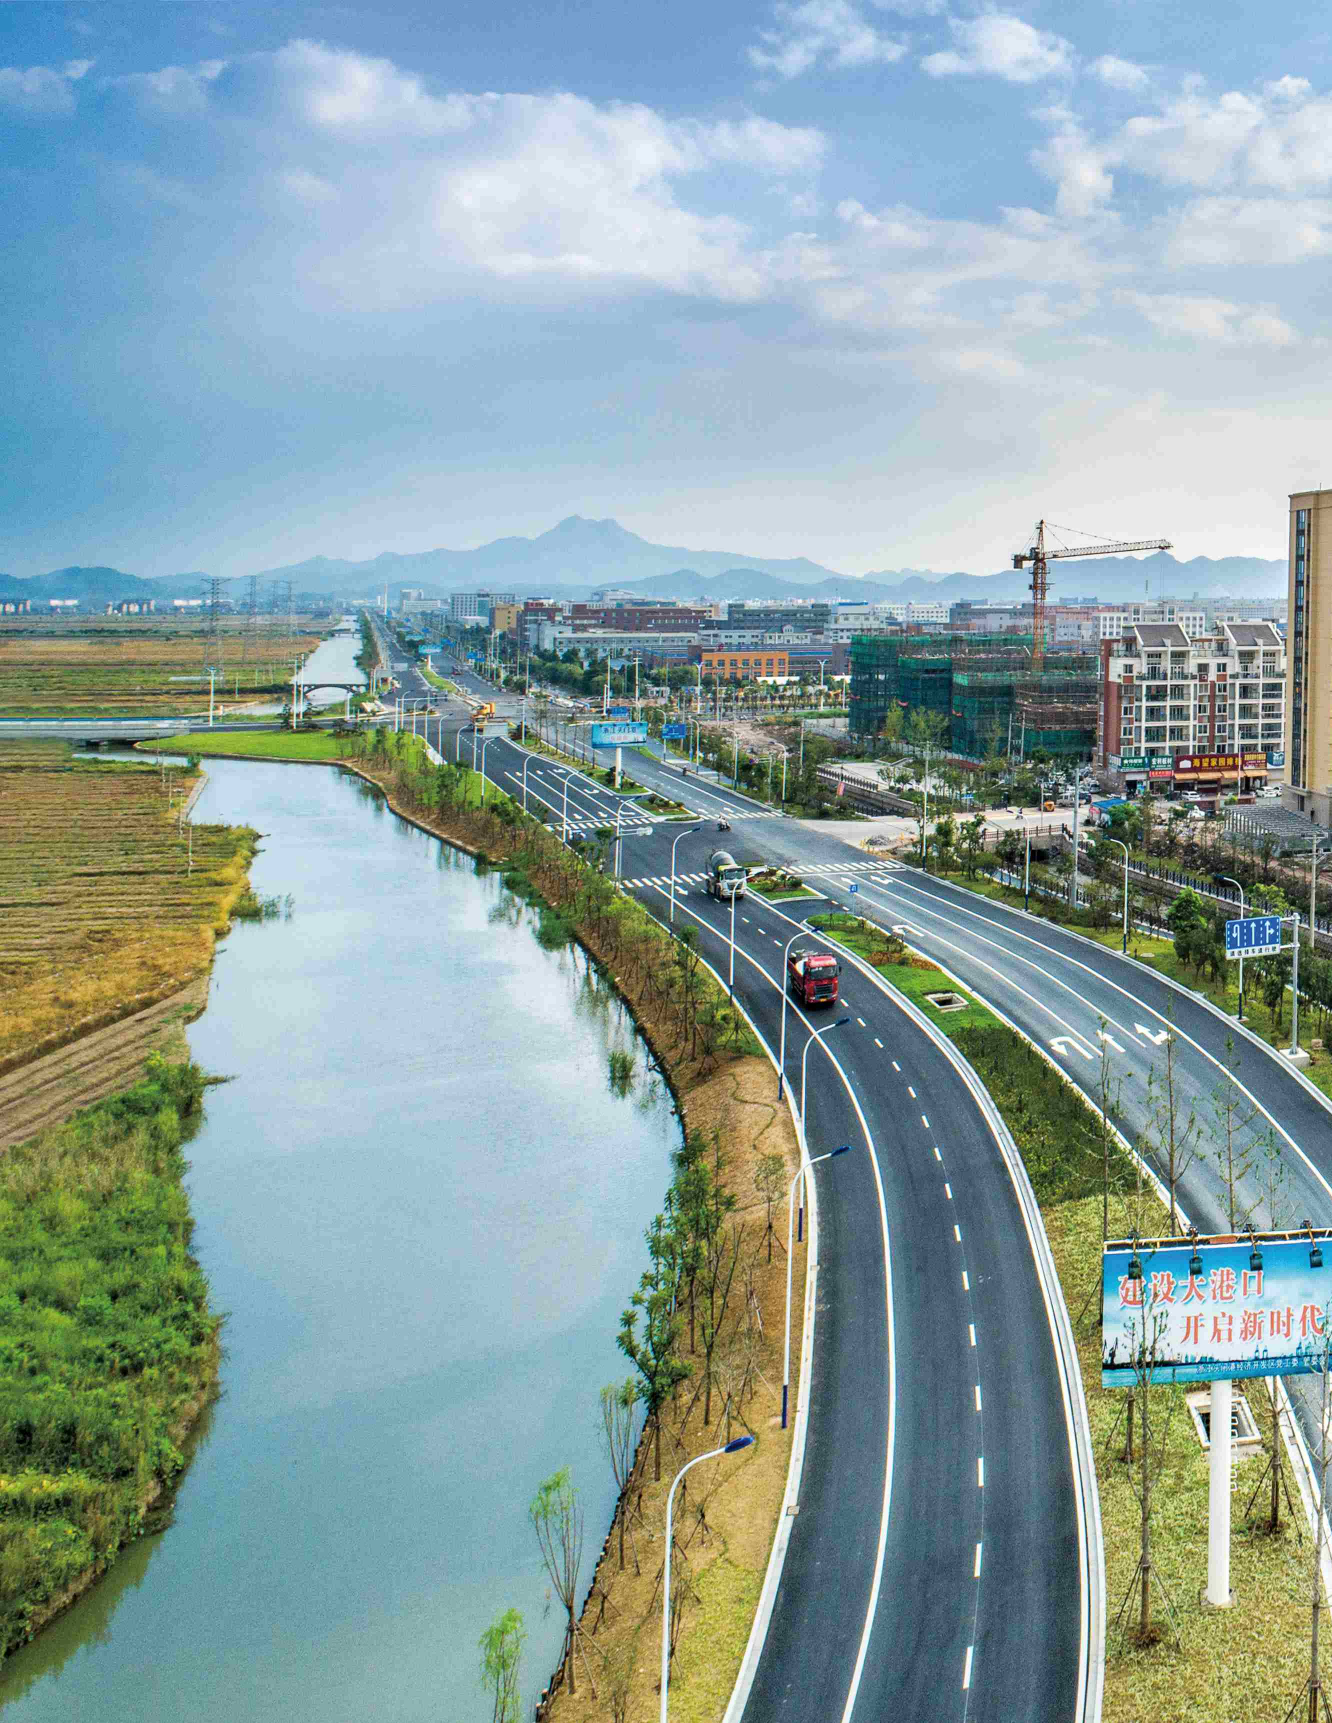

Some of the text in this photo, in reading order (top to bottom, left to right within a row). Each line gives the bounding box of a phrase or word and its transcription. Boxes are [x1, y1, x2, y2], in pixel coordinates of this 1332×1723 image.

[1118, 1267, 1265, 1307] 建设大港口
[1179, 1304, 1325, 1346] 开启新时代
